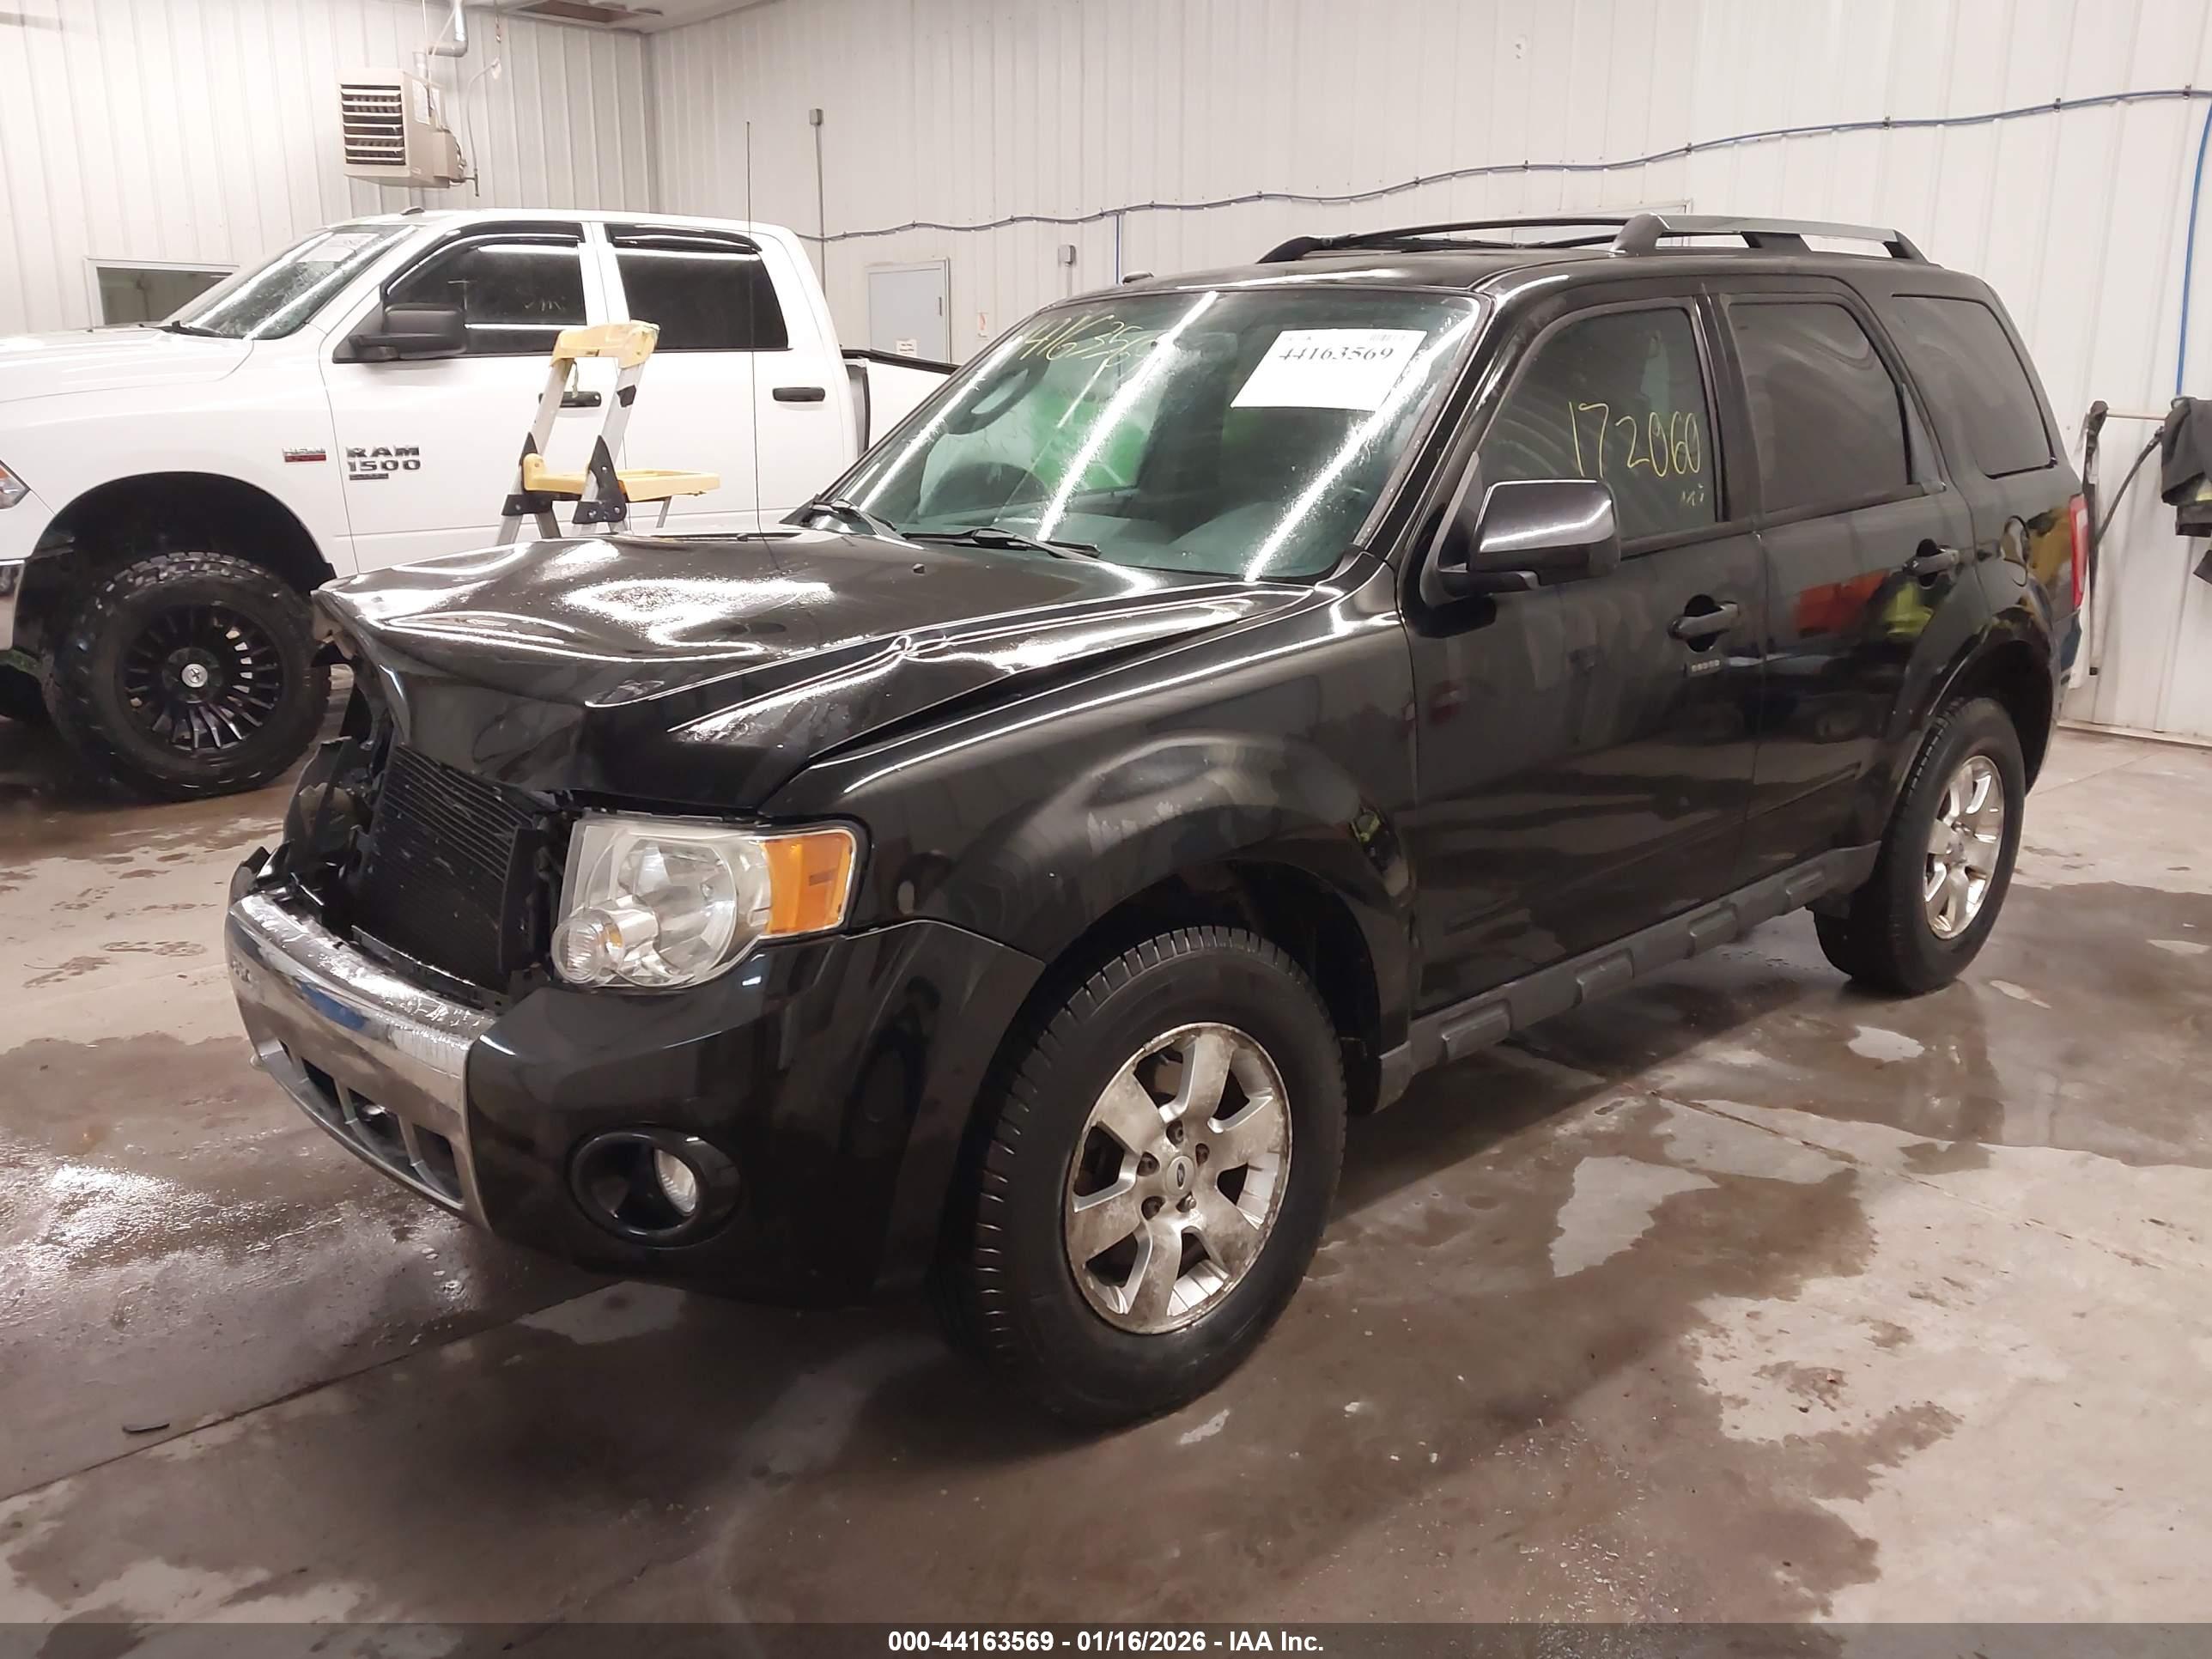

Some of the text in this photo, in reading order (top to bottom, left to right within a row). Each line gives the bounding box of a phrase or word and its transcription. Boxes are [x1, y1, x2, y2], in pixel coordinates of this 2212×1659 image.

[1279, 346, 1395, 362] 44163569
[1568, 401, 1701, 478] 172060
[346, 447, 420, 458] RAM
[347, 459, 422, 472] 1500
